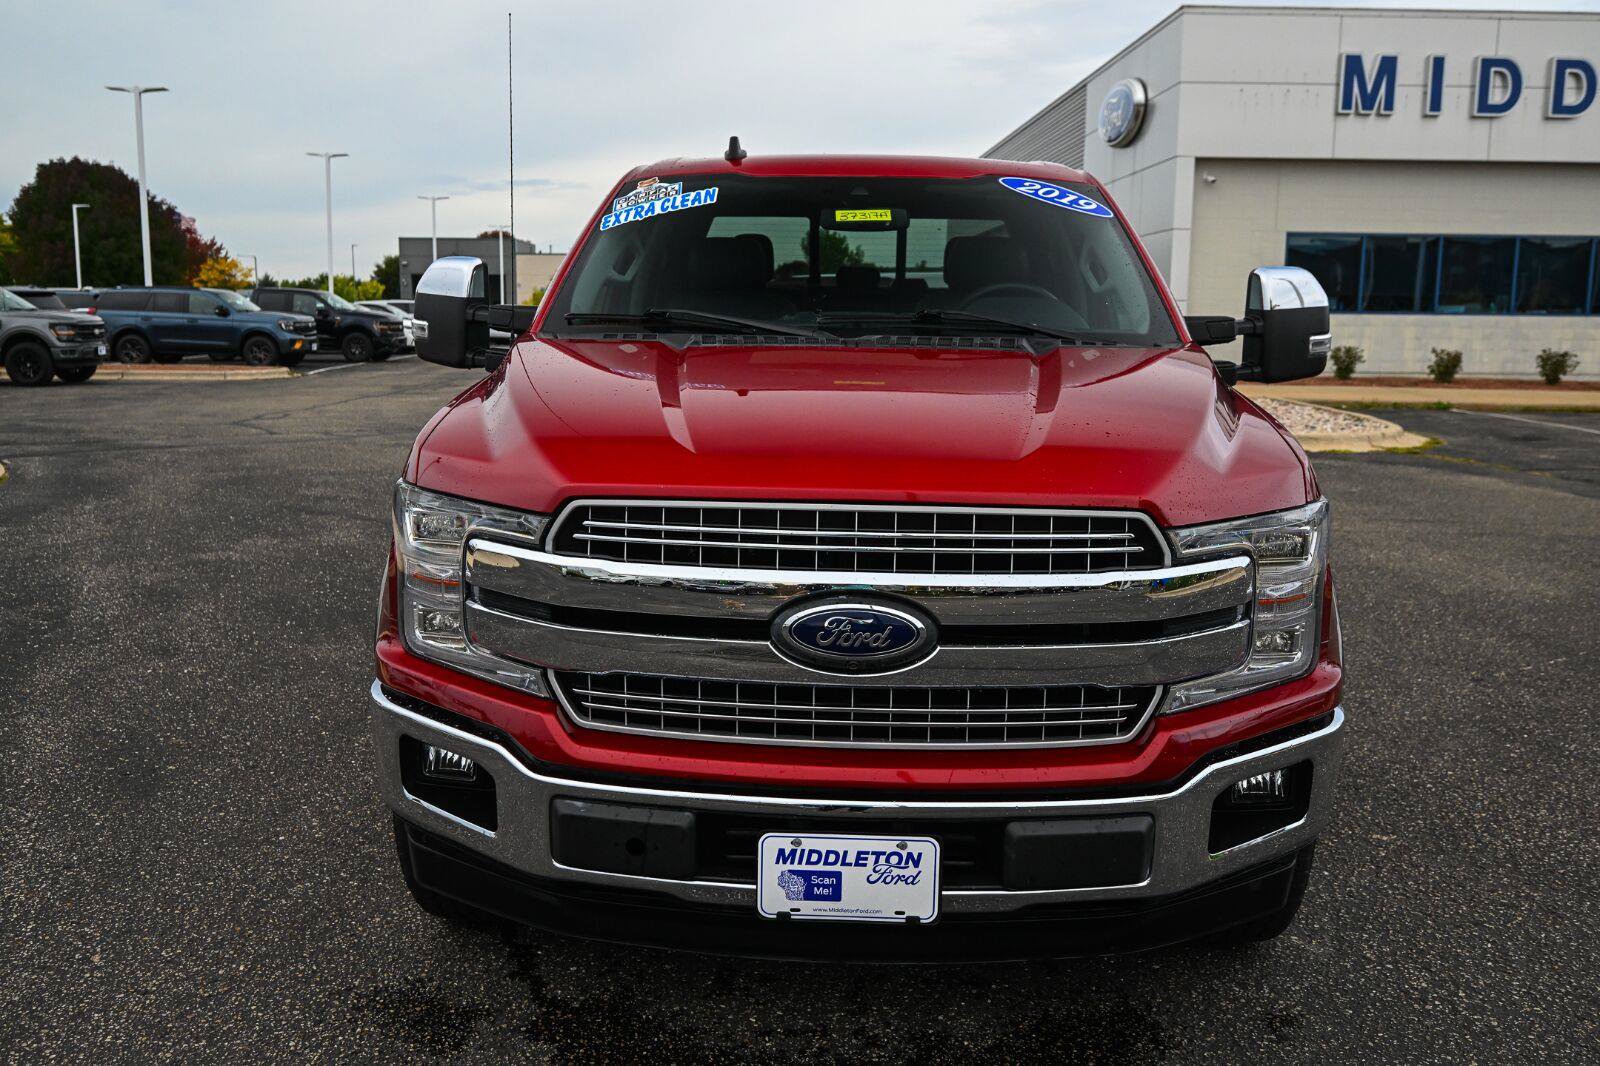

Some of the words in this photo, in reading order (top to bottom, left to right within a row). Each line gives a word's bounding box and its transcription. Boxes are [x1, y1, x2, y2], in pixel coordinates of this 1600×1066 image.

[1337, 53, 1598, 117] MIDD
[1016, 182, 1098, 210] 2019
[601, 202, 656, 230] EXTRA
[660, 188, 718, 213] CLEAN
[816, 616, 893, 648] Ford
[775, 848, 923, 868] MIDDLETON
[811, 875, 836, 885] Scan
[866, 863, 922, 886] Ford
[813, 887, 832, 895] Me!
